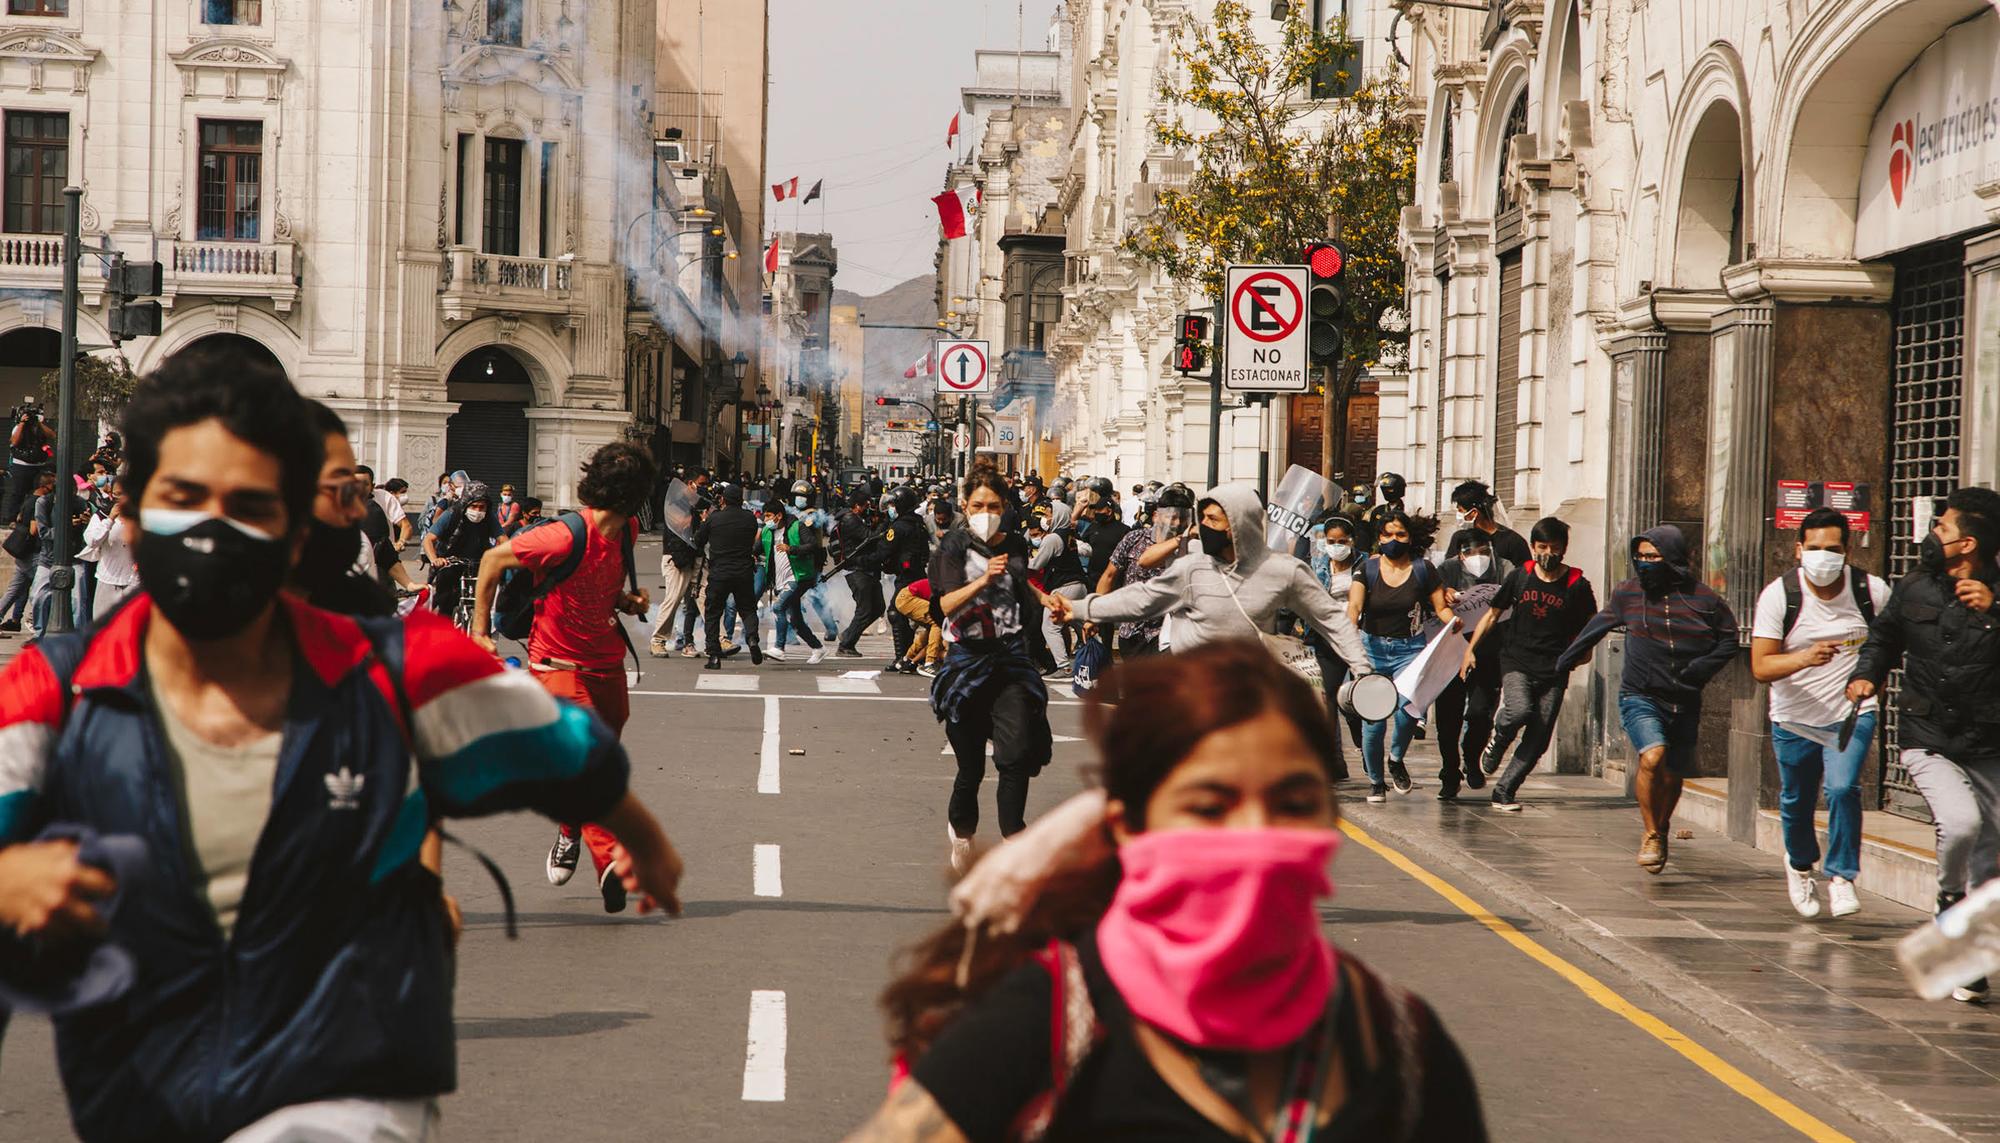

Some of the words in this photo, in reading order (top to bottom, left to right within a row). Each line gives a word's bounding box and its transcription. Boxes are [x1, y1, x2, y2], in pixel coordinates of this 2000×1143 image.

[1253, 348, 1281, 364] NO
[1231, 368, 1301, 381] ESTACIONAR
[999, 430, 1014, 441] 30
